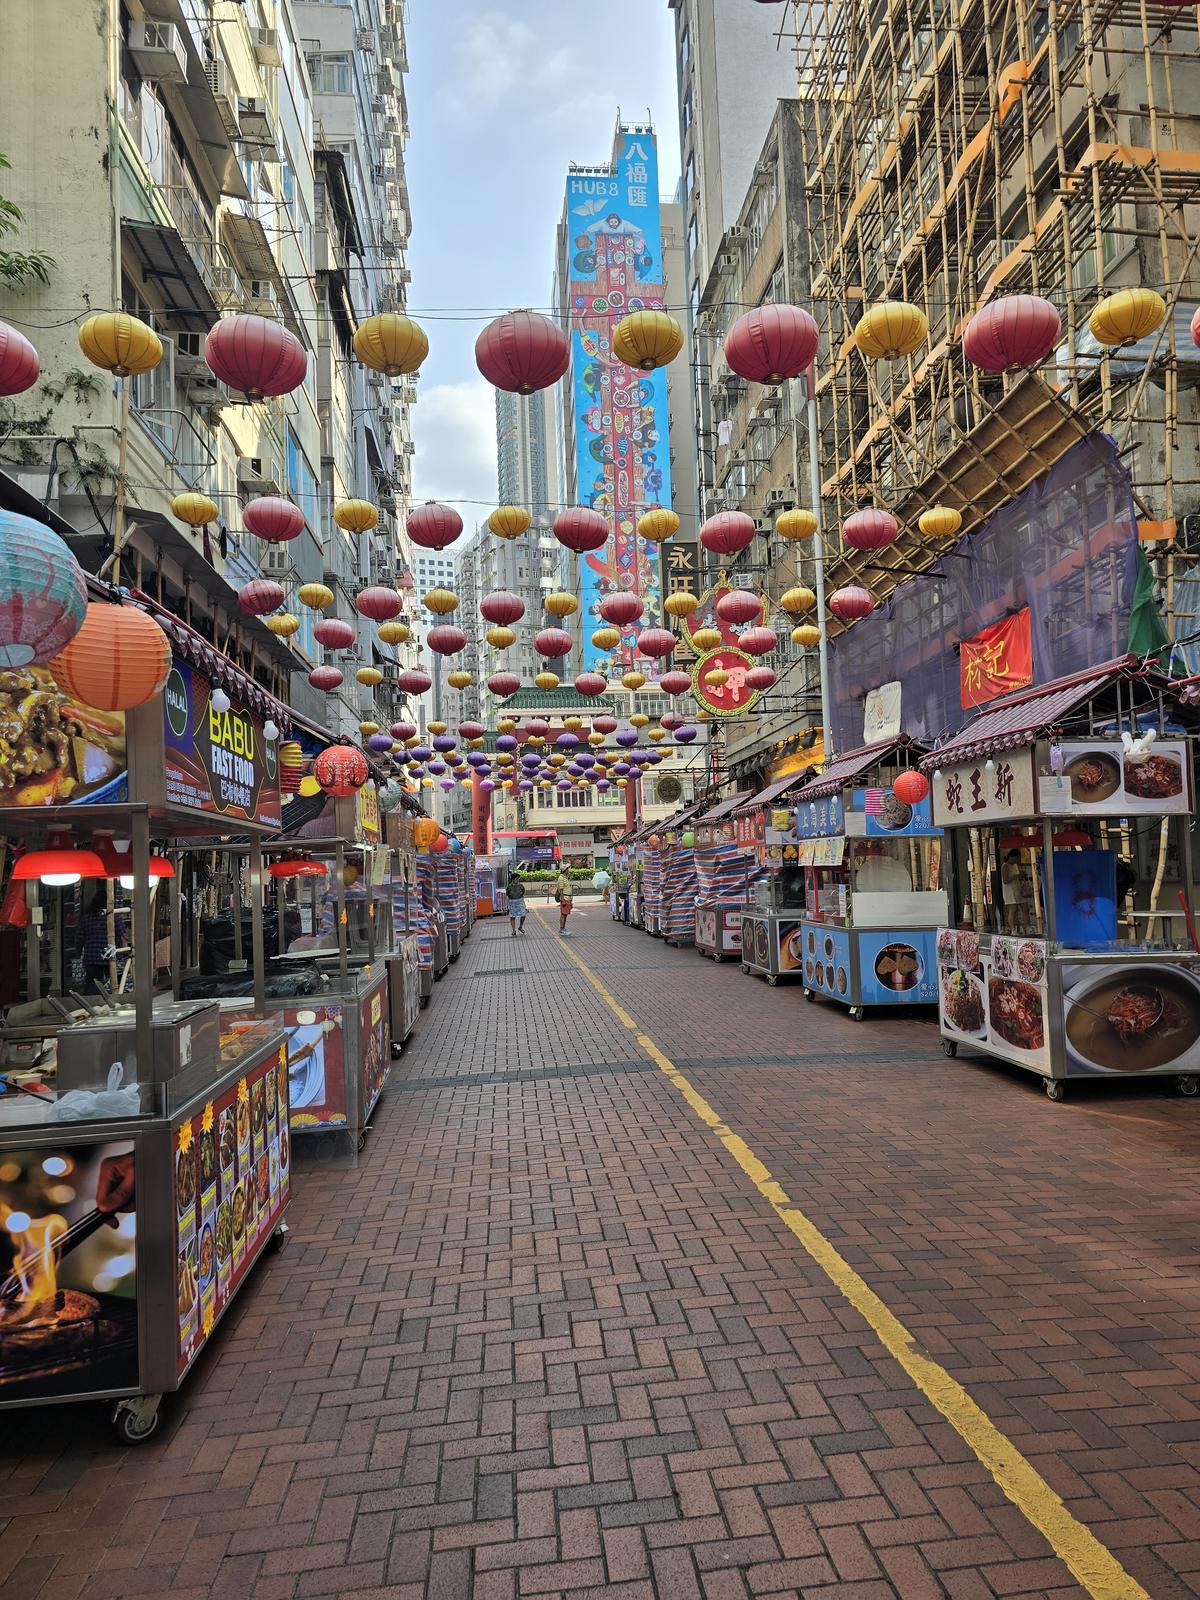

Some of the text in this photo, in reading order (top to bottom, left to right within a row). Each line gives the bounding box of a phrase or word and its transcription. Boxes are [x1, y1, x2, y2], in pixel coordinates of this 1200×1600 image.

[625, 142, 648, 207] 八福匯
[167, 689, 186, 713] HALAL
[209, 701, 254, 760] BABU
[211, 745, 233, 780] FAST
[234, 757, 255, 788] FOOD
[946, 762, 1014, 814] 蛇王新
